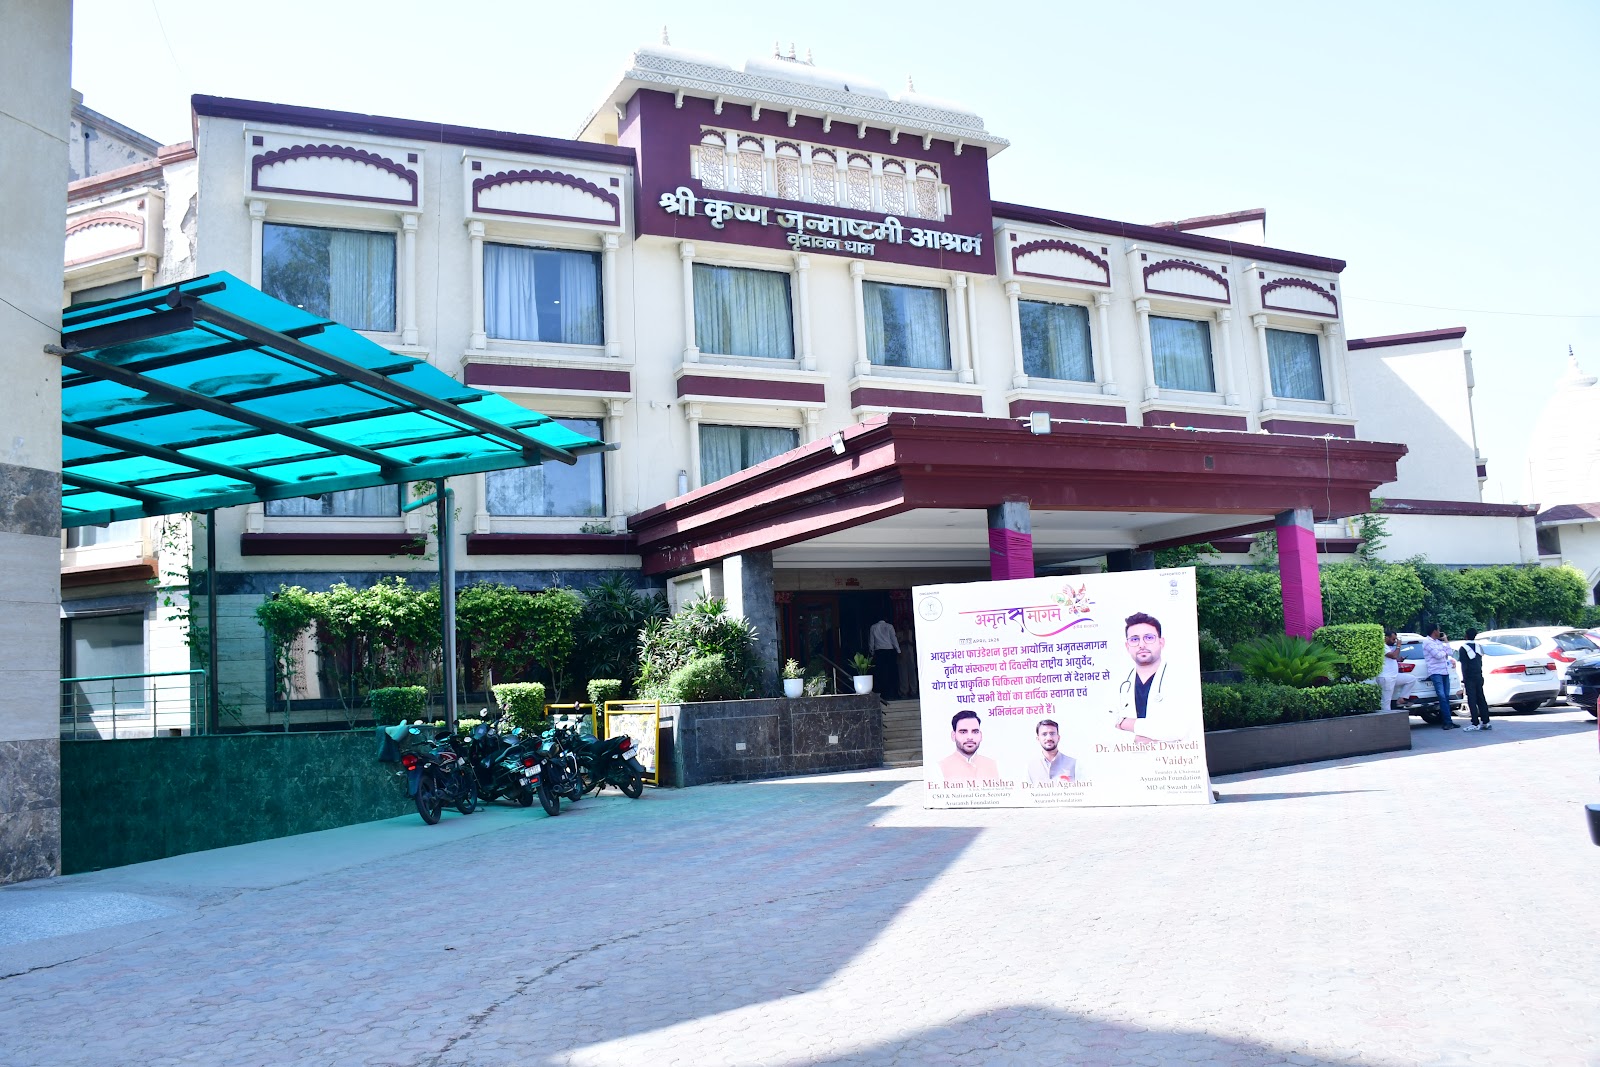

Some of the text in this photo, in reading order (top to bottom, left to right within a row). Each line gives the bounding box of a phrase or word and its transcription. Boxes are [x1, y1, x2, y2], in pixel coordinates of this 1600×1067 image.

[659, 186, 982, 255] श्री कृष्ण जन्माष्टमी आश्रम
[845, 240, 875, 256] धाम
[930, 640, 1107, 664] आयुरअंश फाउंडेशन द्वारा आयोजित अमृतसमागम
[944, 664, 963, 678] तृतीय
[965, 661, 997, 673] संस्करण
[999, 660, 1007, 671] दो
[1009, 659, 1038, 671] दिवसीय
[1040, 657, 1063, 669] राष्ट्रीय
[932, 669, 1110, 692] योग एवं प्राकृतिक चिकित्सा कार्यशाला में देशभर से
[957, 692, 976, 704] पधारे
[977, 691, 995, 703] सभी
[1013, 690, 1023, 701] का
[1025, 687, 1048, 700] हार्दिक
[1050, 687, 1074, 699] स्वागत
[1076, 686, 1088, 697] एवं
[988, 706, 1024, 717] अभिनंदन
[1026, 703, 1045, 715] करते
[1095, 740, 1199, 753] Dr. Abhishek Dwivedi
[927, 781, 940, 790] Er.
[943, 780, 964, 789] Ram
[966, 779, 979, 788] M.
[982, 778, 1015, 788] Mishra
[1021, 781, 1034, 790] Dr.
[1037, 780, 1055, 789] Atul
[1057, 780, 1093, 790] Agrahari
